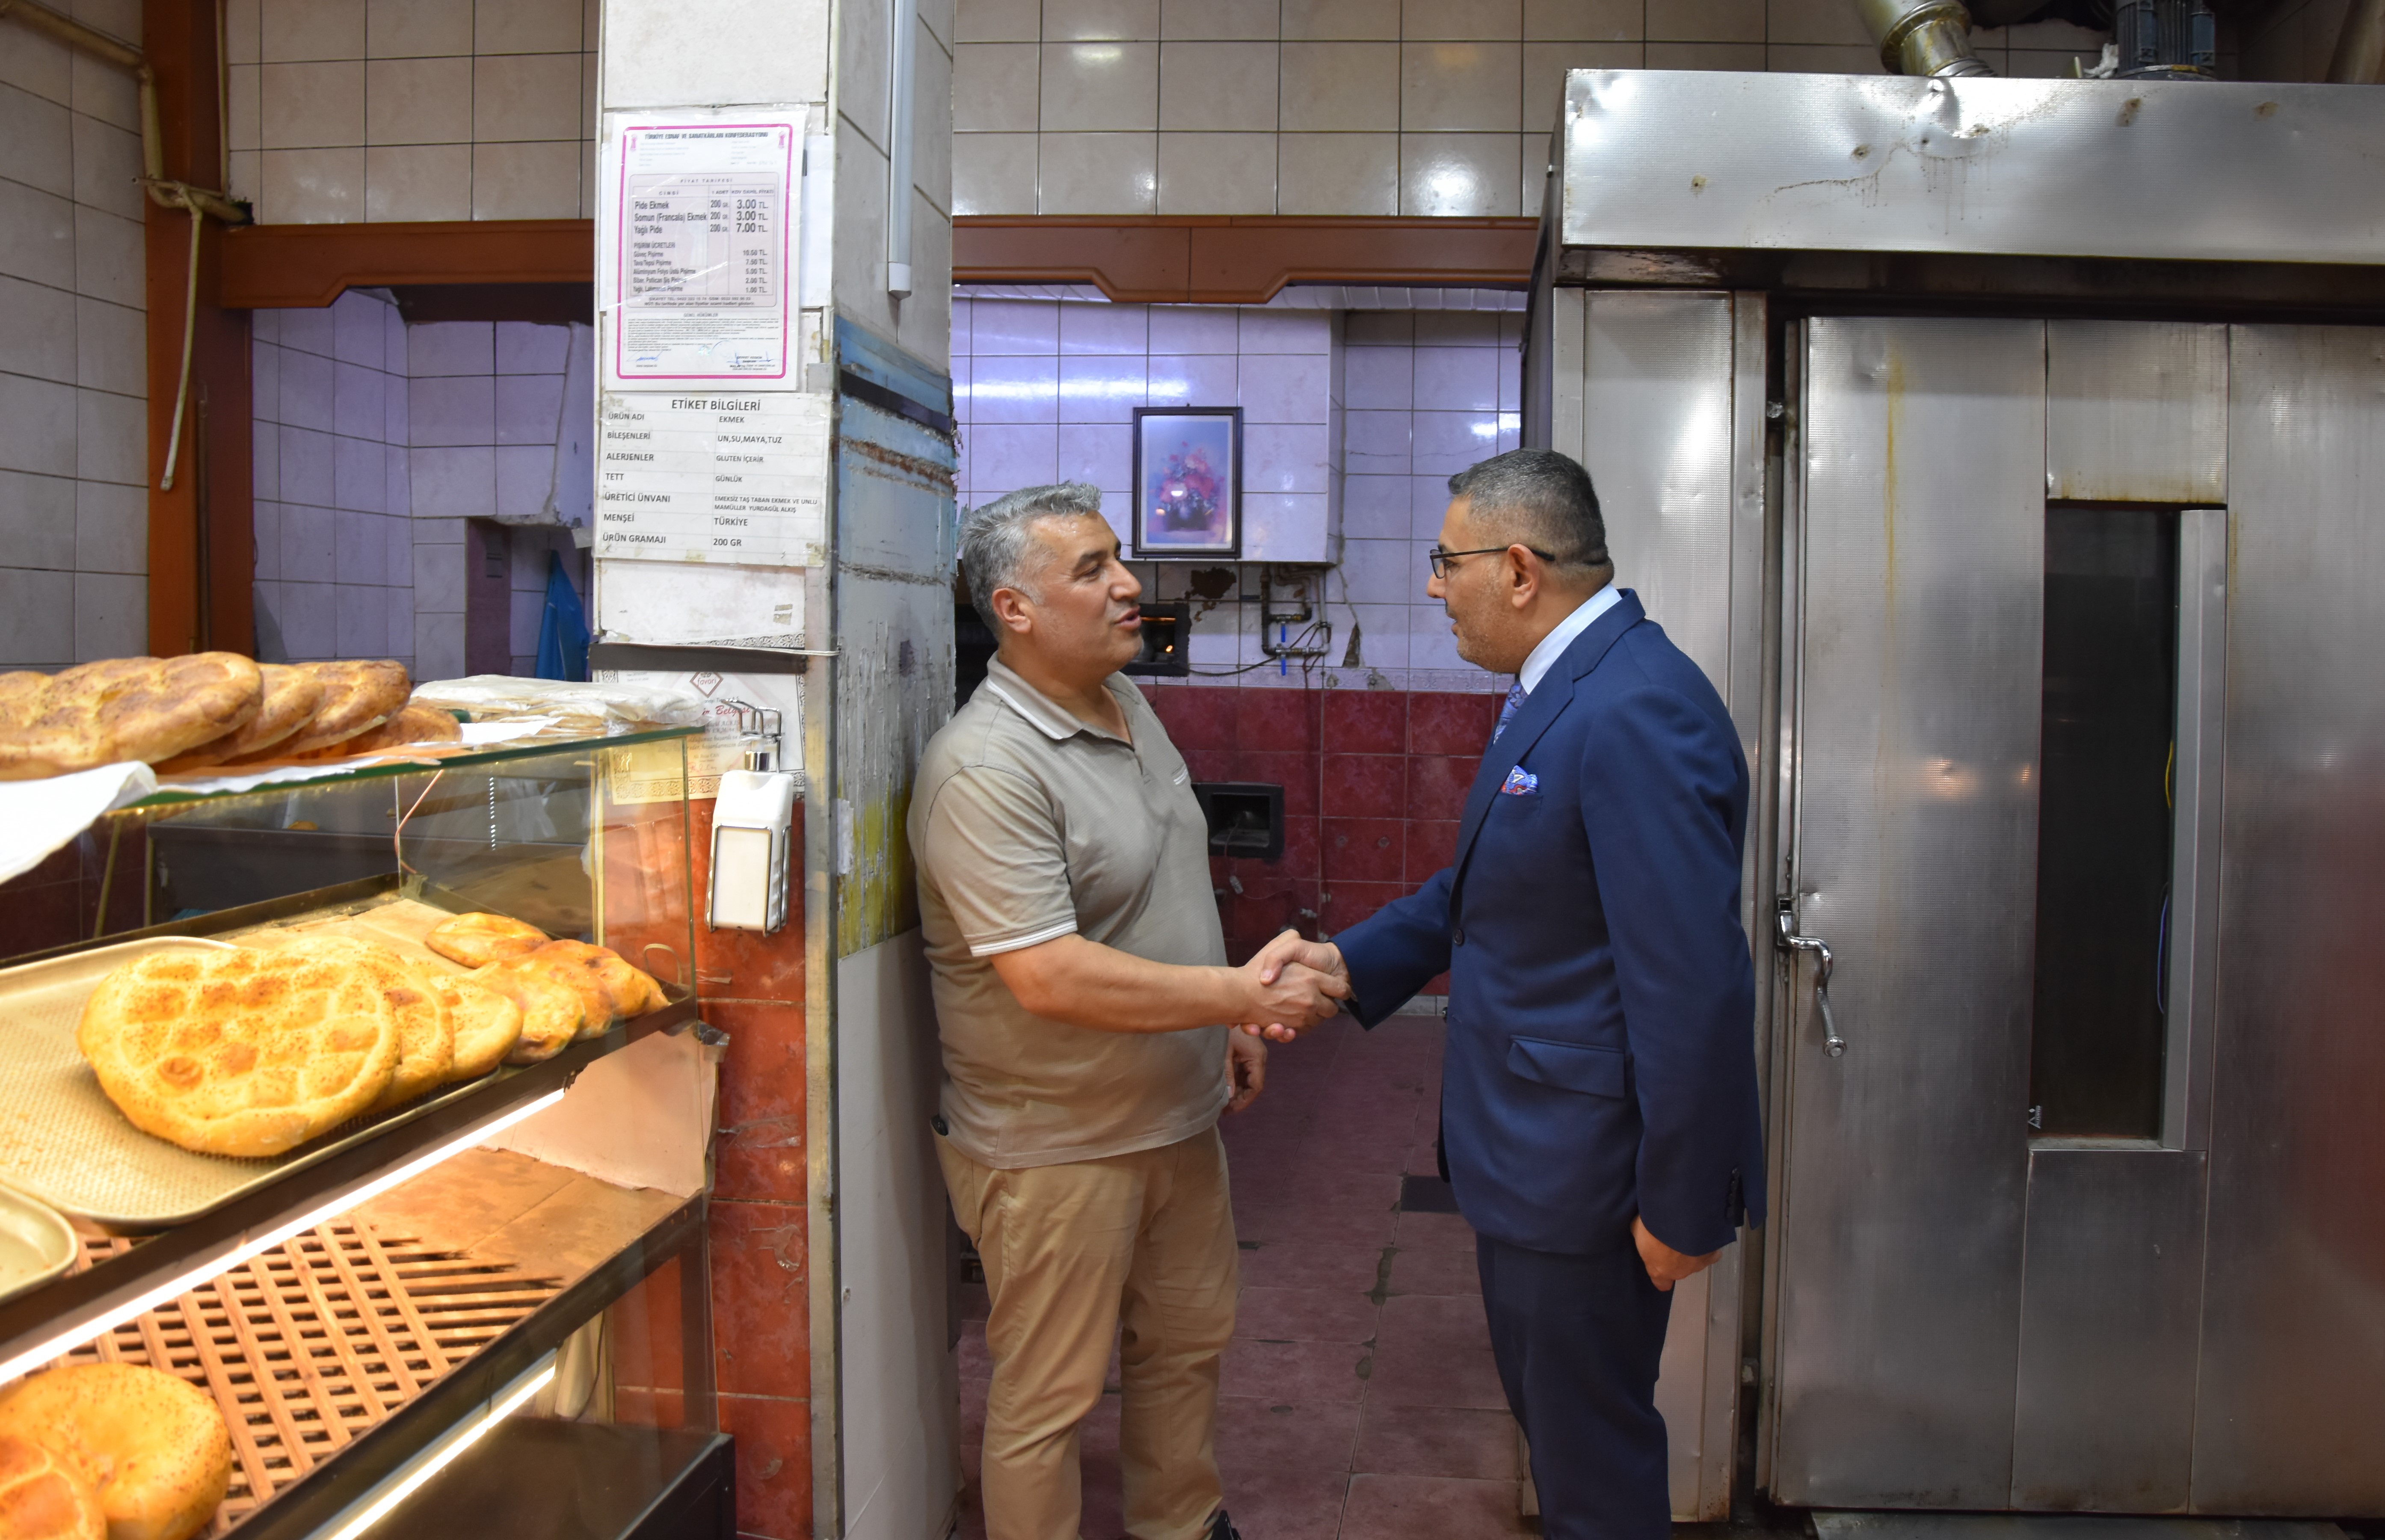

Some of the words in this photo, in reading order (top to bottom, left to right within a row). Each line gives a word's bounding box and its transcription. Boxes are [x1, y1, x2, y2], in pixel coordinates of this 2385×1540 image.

[635, 201, 647, 209] Pide
[649, 201, 669, 209] Ekmek
[737, 199, 756, 209] 3.00
[634, 213, 655, 222] Somun
[656, 213, 685, 223] (Francala)
[687, 213, 707, 221] Ekmek
[710, 211, 721, 219] 200
[736, 211, 756, 221] 3.00
[634, 225, 647, 236] Yağlı
[649, 225, 662, 234] Pide
[710, 224, 720, 232] 200
[736, 222, 755, 232] 7.00
[672, 398, 708, 410] ETİKET
[711, 399, 761, 411] BİLGİLERİ
[608, 412, 630, 420] ÜRÜN
[607, 431, 651, 440] BİLEŞENLERİ
[717, 435, 782, 444] UN,SU,MAYA,TUZ
[606, 453, 654, 461] ALERJENLER
[743, 455, 764, 463] İÇERİR
[604, 492, 635, 501] ÜRETİCİ
[638, 493, 670, 503] ÜNVANI
[603, 513, 634, 523] MENŞEİ
[714, 516, 748, 526] TÜRKİYE
[603, 533, 626, 542] ÜRÜN
[629, 534, 666, 543] GRAMAJI
[697, 678, 716, 687] favori
[715, 705, 750, 717] Belgsi
